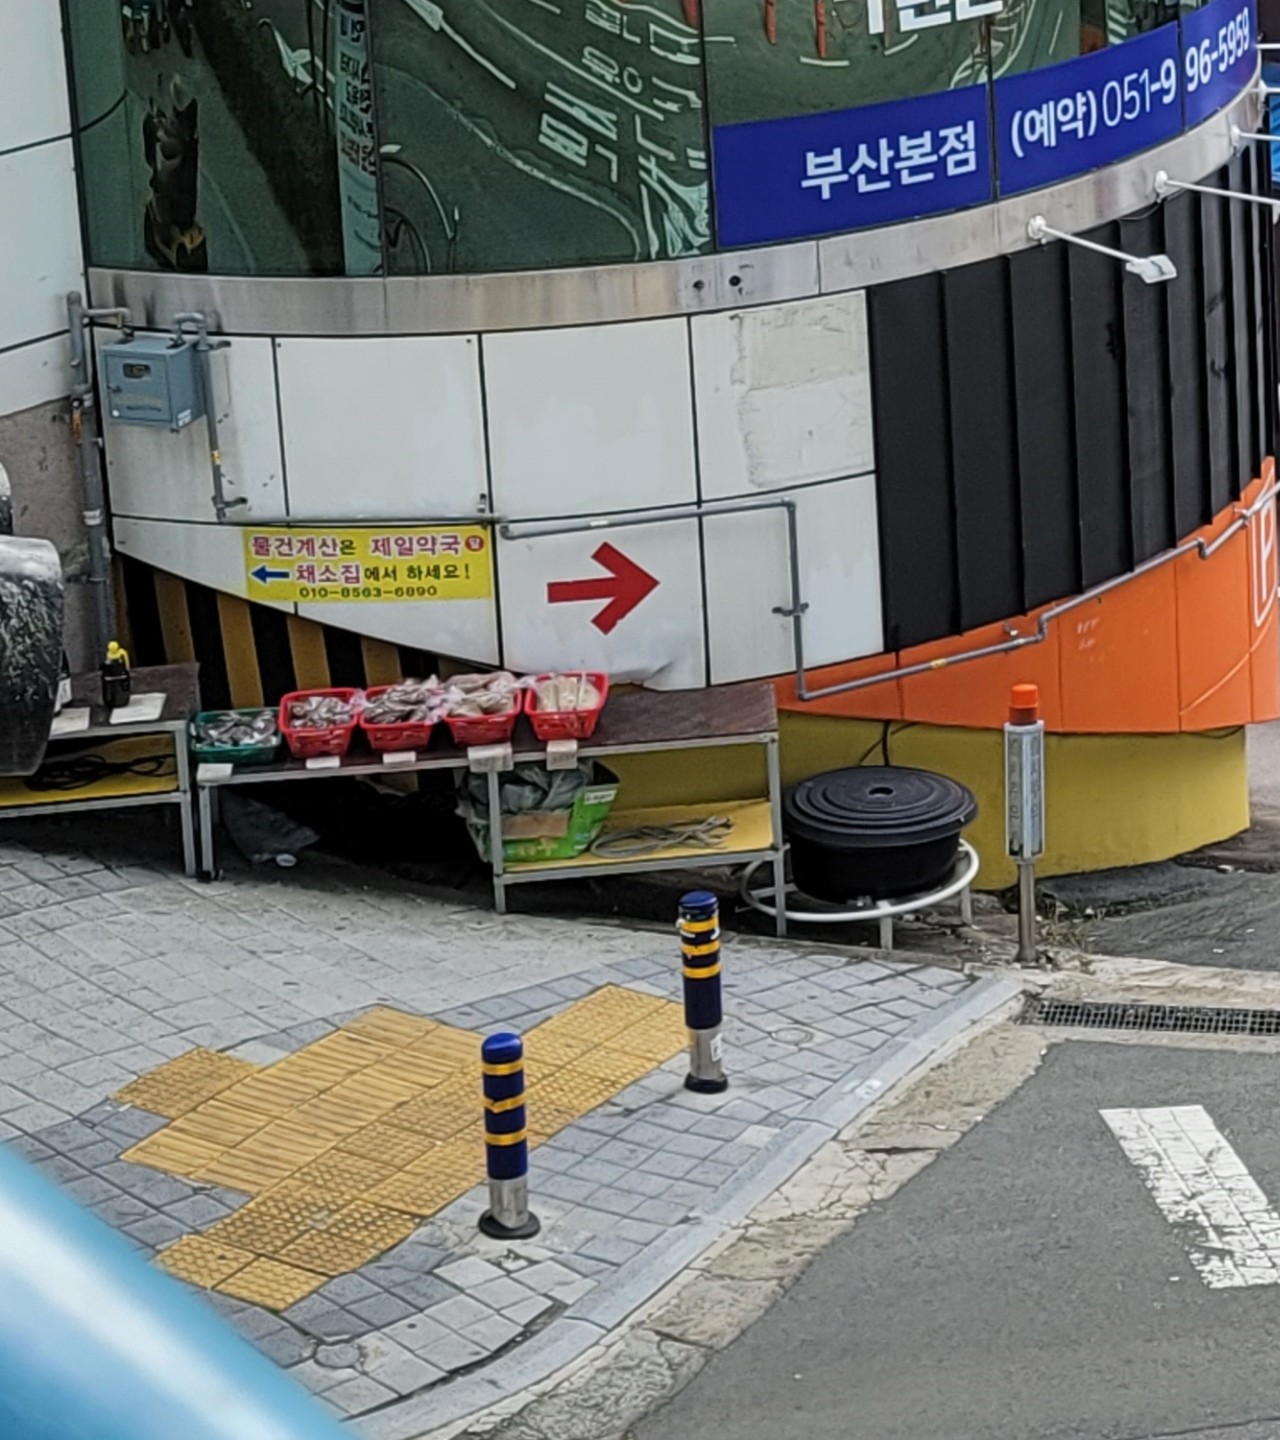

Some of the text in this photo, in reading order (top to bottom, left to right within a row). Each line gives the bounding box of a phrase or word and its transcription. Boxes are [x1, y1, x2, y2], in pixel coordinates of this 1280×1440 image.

[800, 119, 981, 202] 부산본점
[251, 535, 358, 558] 물건계산은
[370, 533, 462, 558] 제일약국
[296, 562, 471, 585] 채소집에서 하세요!
